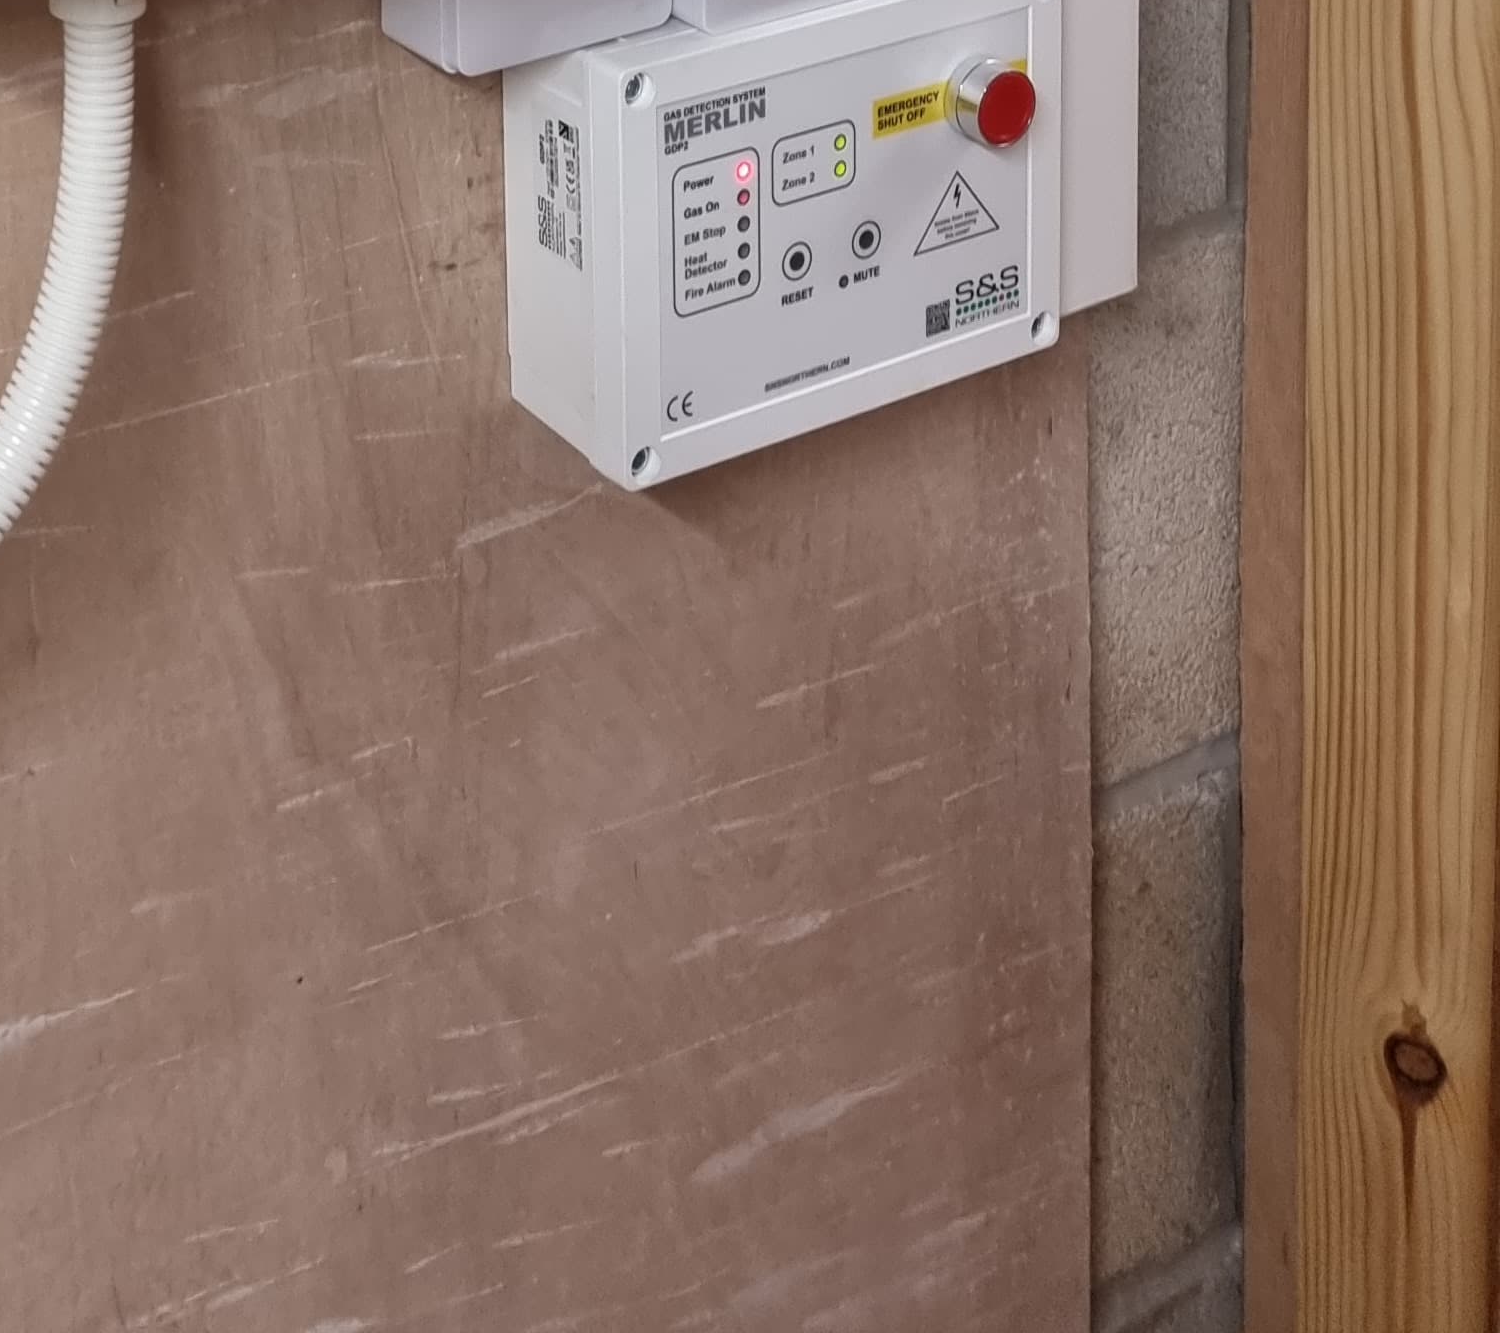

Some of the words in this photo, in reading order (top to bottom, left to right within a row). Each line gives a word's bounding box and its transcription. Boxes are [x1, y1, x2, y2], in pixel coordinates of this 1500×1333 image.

[663, 109, 682, 122] GAS
[683, 96, 731, 119] DETECTION
[733, 86, 766, 104] SYSTEM
[877, 90, 939, 117] EMERGENCY
[664, 99, 766, 145] MERLIN
[877, 113, 904, 131] SHUT
[907, 107, 926, 122] OFF
[782, 149, 807, 165] Zone
[683, 175, 714, 193] Power
[782, 176, 807, 191] Zone
[809, 172, 815, 183] 2
[684, 206, 703, 219] Gas
[705, 202, 720, 214] On
[684, 233, 701, 245] EM
[703, 225, 726, 240] Stop
[684, 252, 708, 267] Heat
[685, 259, 727, 280] Detector
[853, 265, 880, 284] MUTE
[685, 285, 704, 301] Fire
[706, 278, 736, 295] Alarm
[955, 265, 1019, 305] S&S
[781, 286, 814, 306] RESET
[954, 298, 1020, 328] NORTHERN
